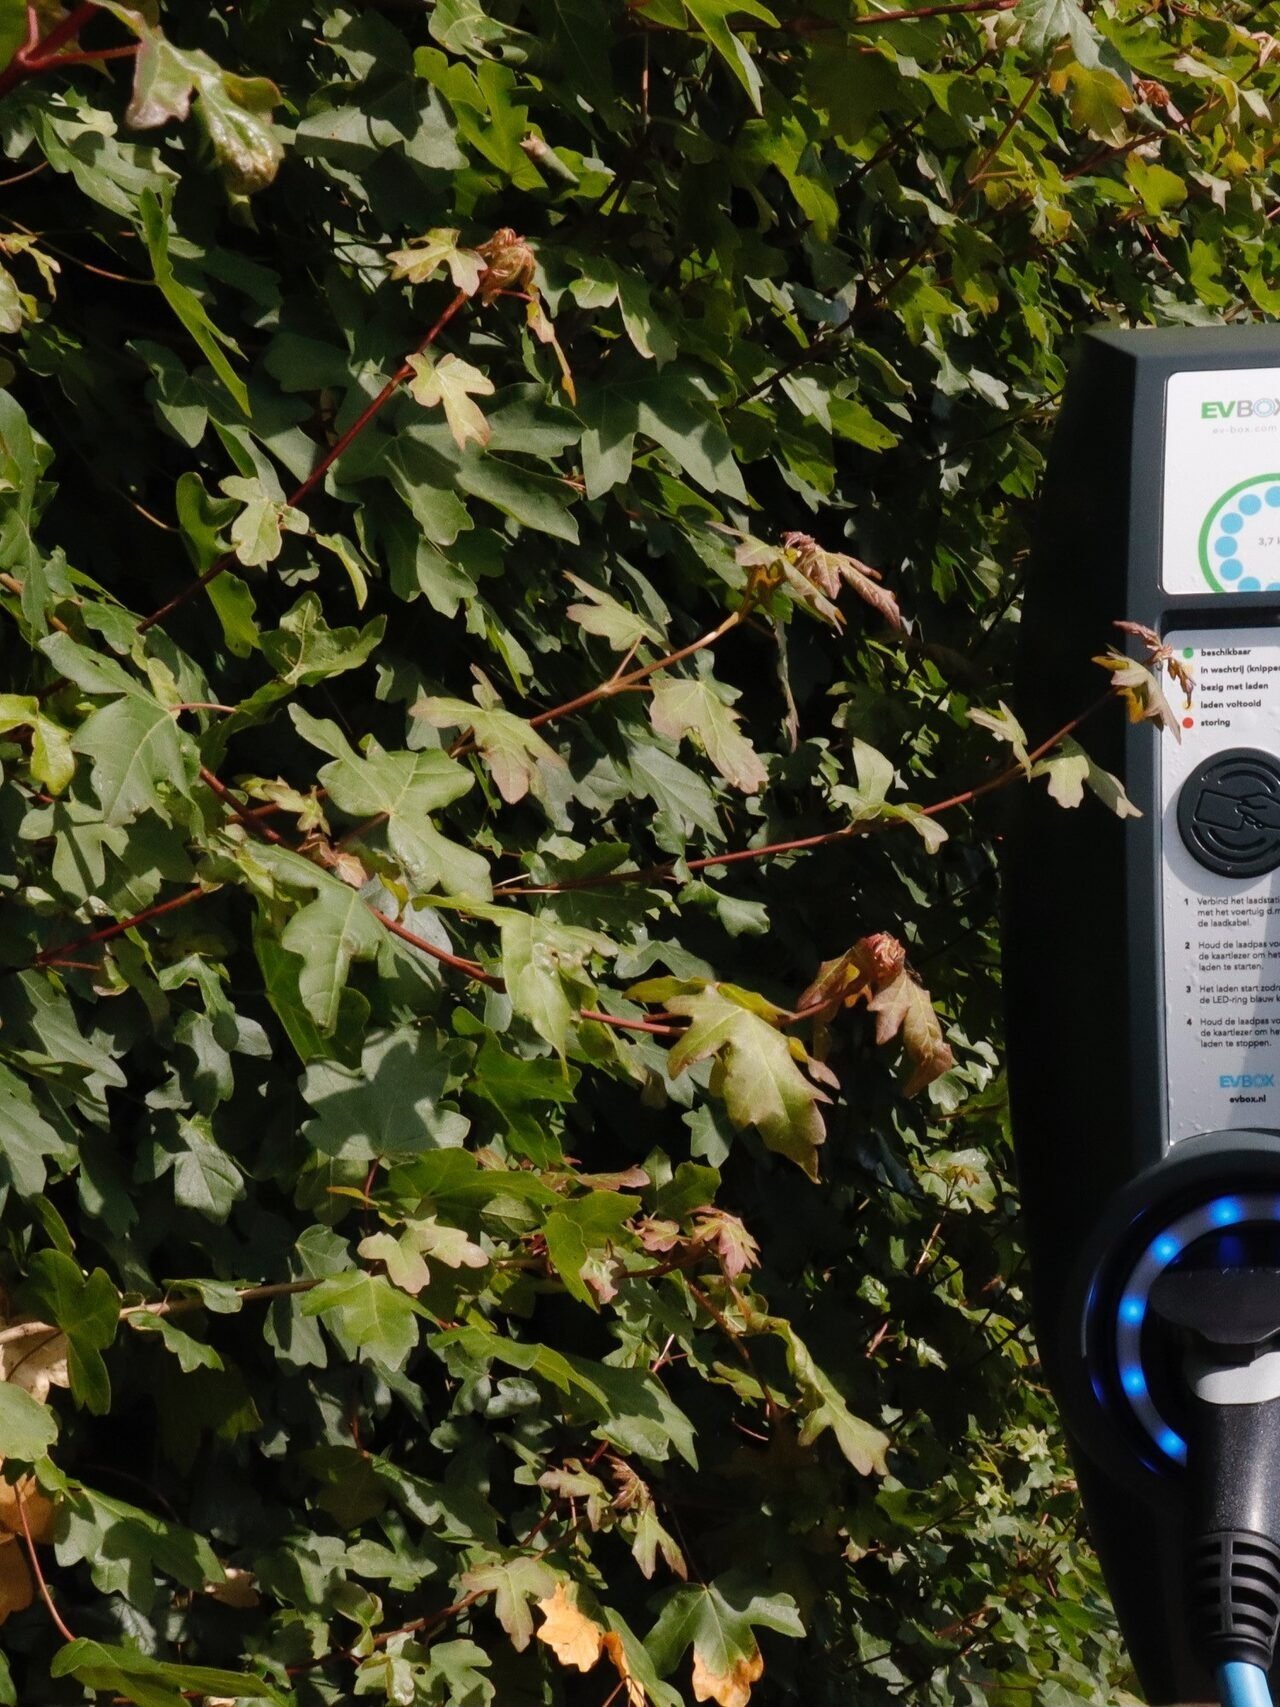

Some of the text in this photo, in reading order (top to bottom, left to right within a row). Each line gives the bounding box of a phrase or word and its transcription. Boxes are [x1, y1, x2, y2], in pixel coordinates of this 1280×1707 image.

[1212, 424, 1277, 434] ev-box.com
[1258, 537, 1273, 546] 3,7
[1211, 665, 1244, 674] wachtrij
[1201, 684, 1223, 692] bezig
[1227, 700, 1261, 708] voltooid
[1201, 719, 1230, 727] storing
[1231, 908, 1264, 917] voertuig
[1236, 941, 1267, 949] laadpas
[1213, 996, 1247, 1004] LED-ring
[1200, 1018, 1222, 1026] Houd
[1238, 1017, 1269, 1026] laadpas
[1201, 1040, 1223, 1048] laden
[1236, 1040, 1271, 1048] stoppen.
[1219, 1074, 1274, 1088] EVBOX
[1230, 1095, 1266, 1103] evbox.nl
